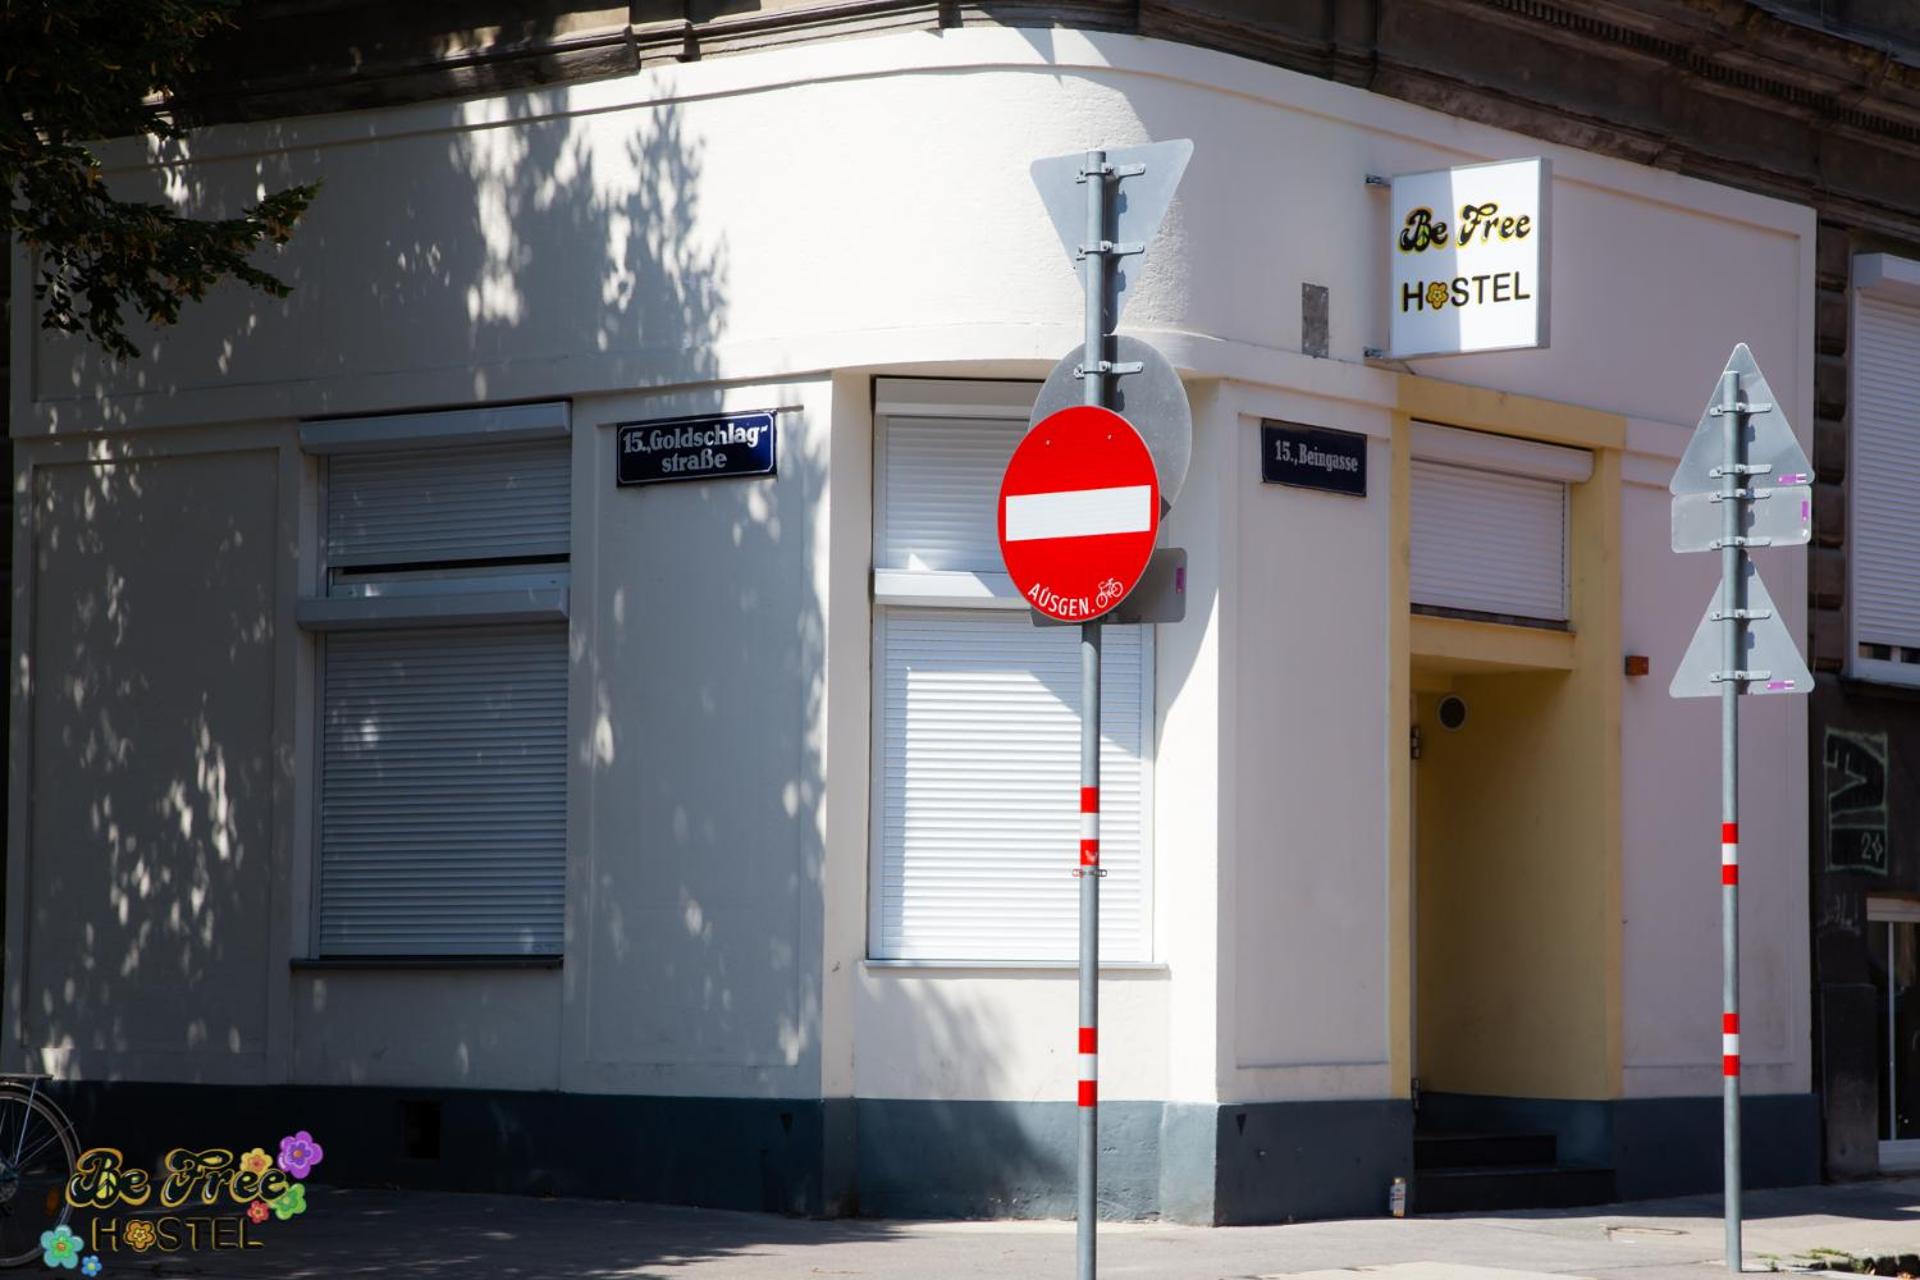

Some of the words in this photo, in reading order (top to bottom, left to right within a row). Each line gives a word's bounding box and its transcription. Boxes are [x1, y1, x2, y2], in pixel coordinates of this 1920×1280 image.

[1399, 206, 1448, 252] Be
[1457, 203, 1531, 247] Free
[661, 449, 728, 473] straße
[1298, 443, 1359, 472] Beingasse
